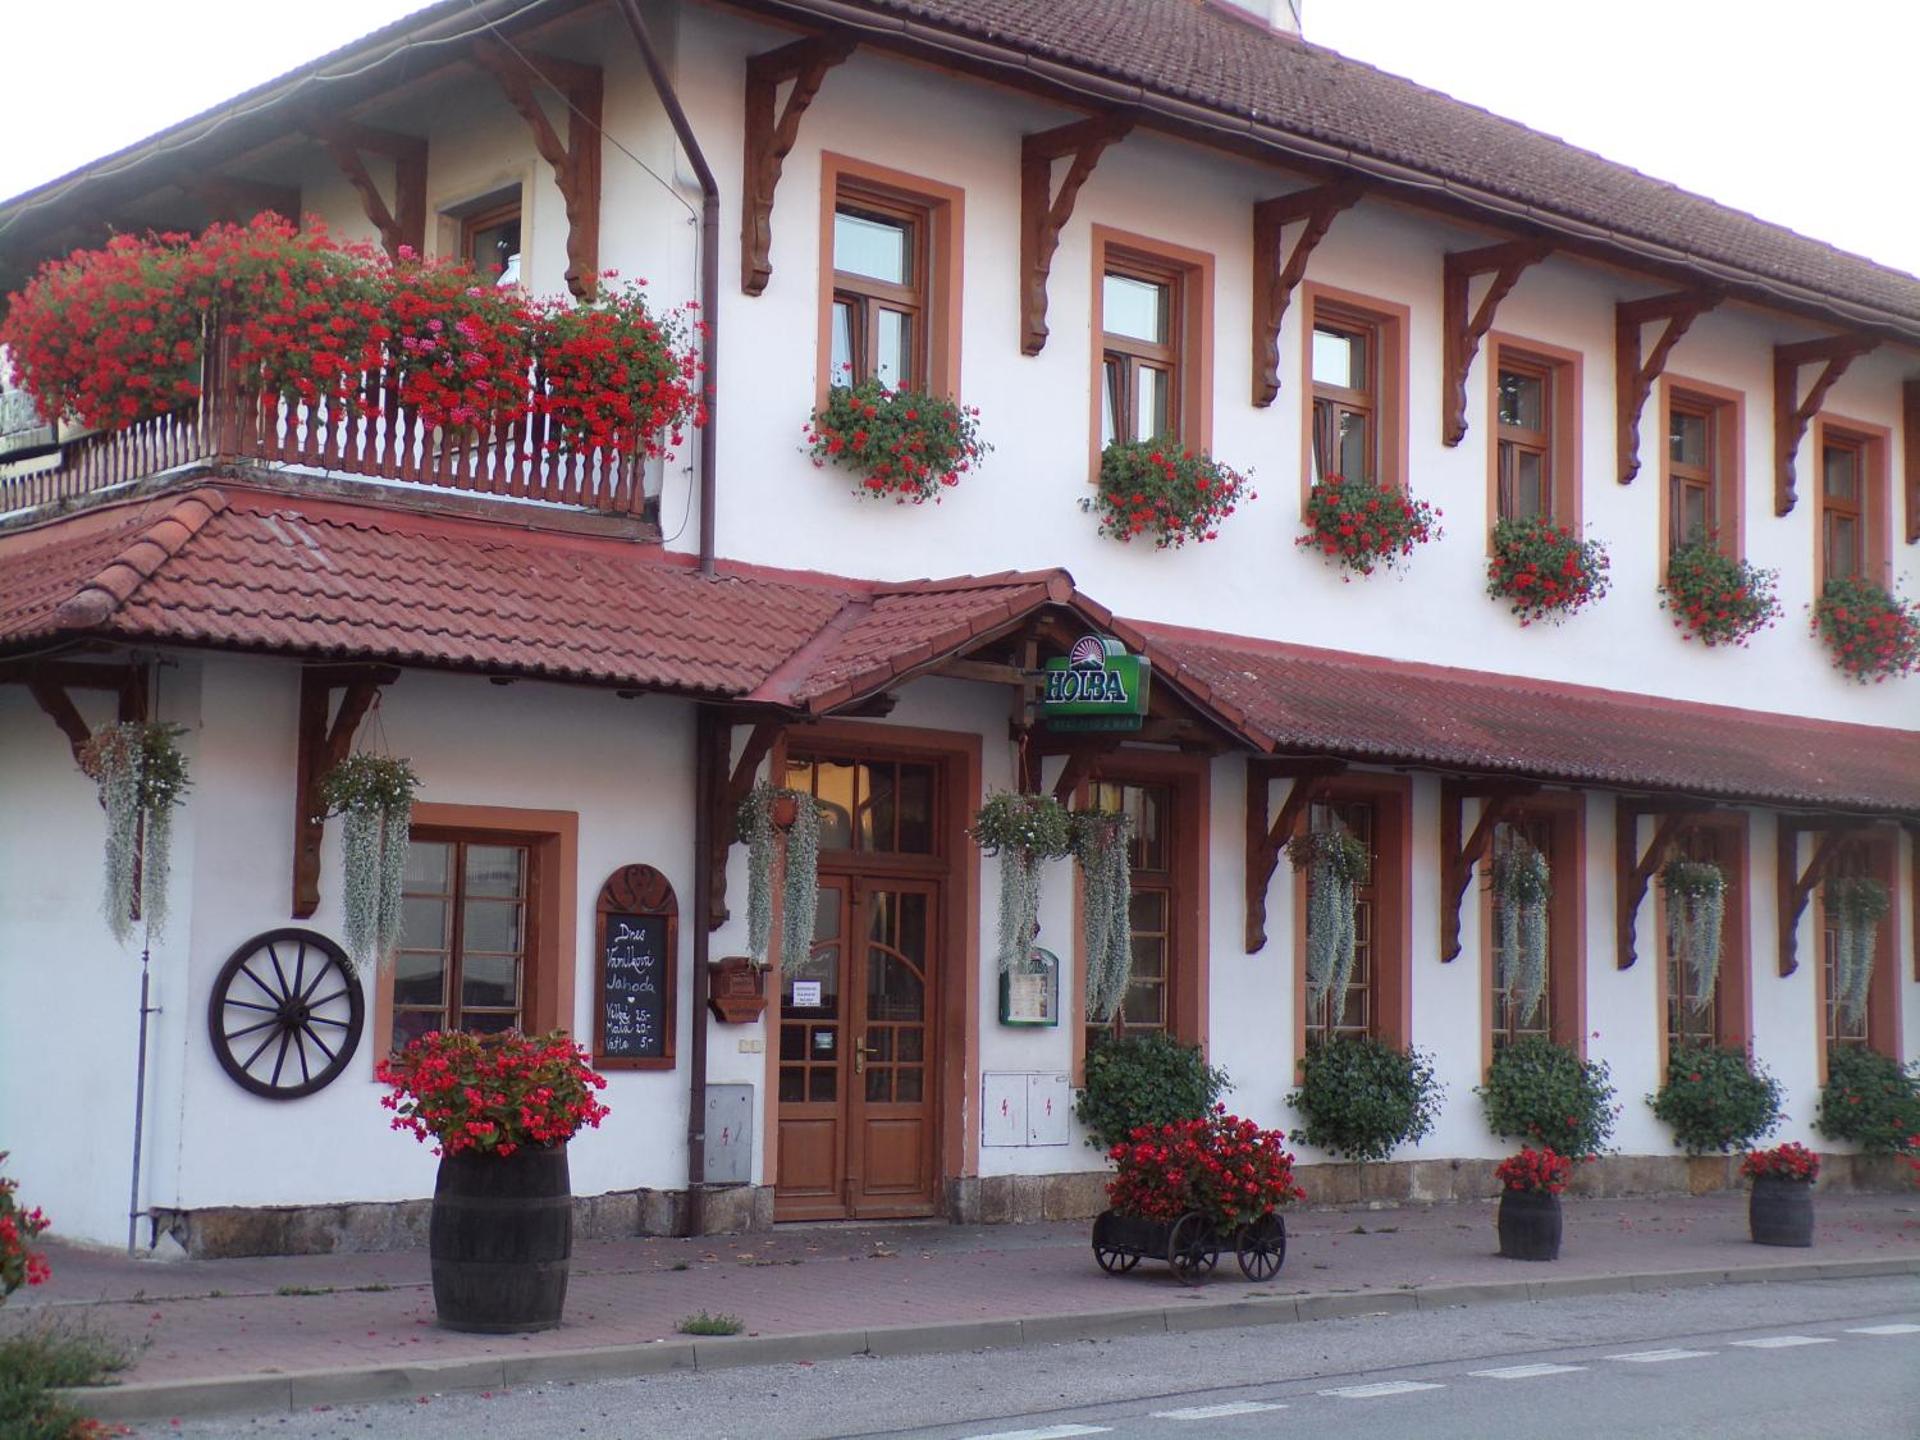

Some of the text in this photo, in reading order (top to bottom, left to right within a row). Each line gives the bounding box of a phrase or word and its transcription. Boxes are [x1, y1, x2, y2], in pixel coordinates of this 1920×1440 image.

[1045, 670, 1128, 703] HOLBA
[614, 923, 646, 942] Dnes
[606, 974, 656, 993] Jahoda
